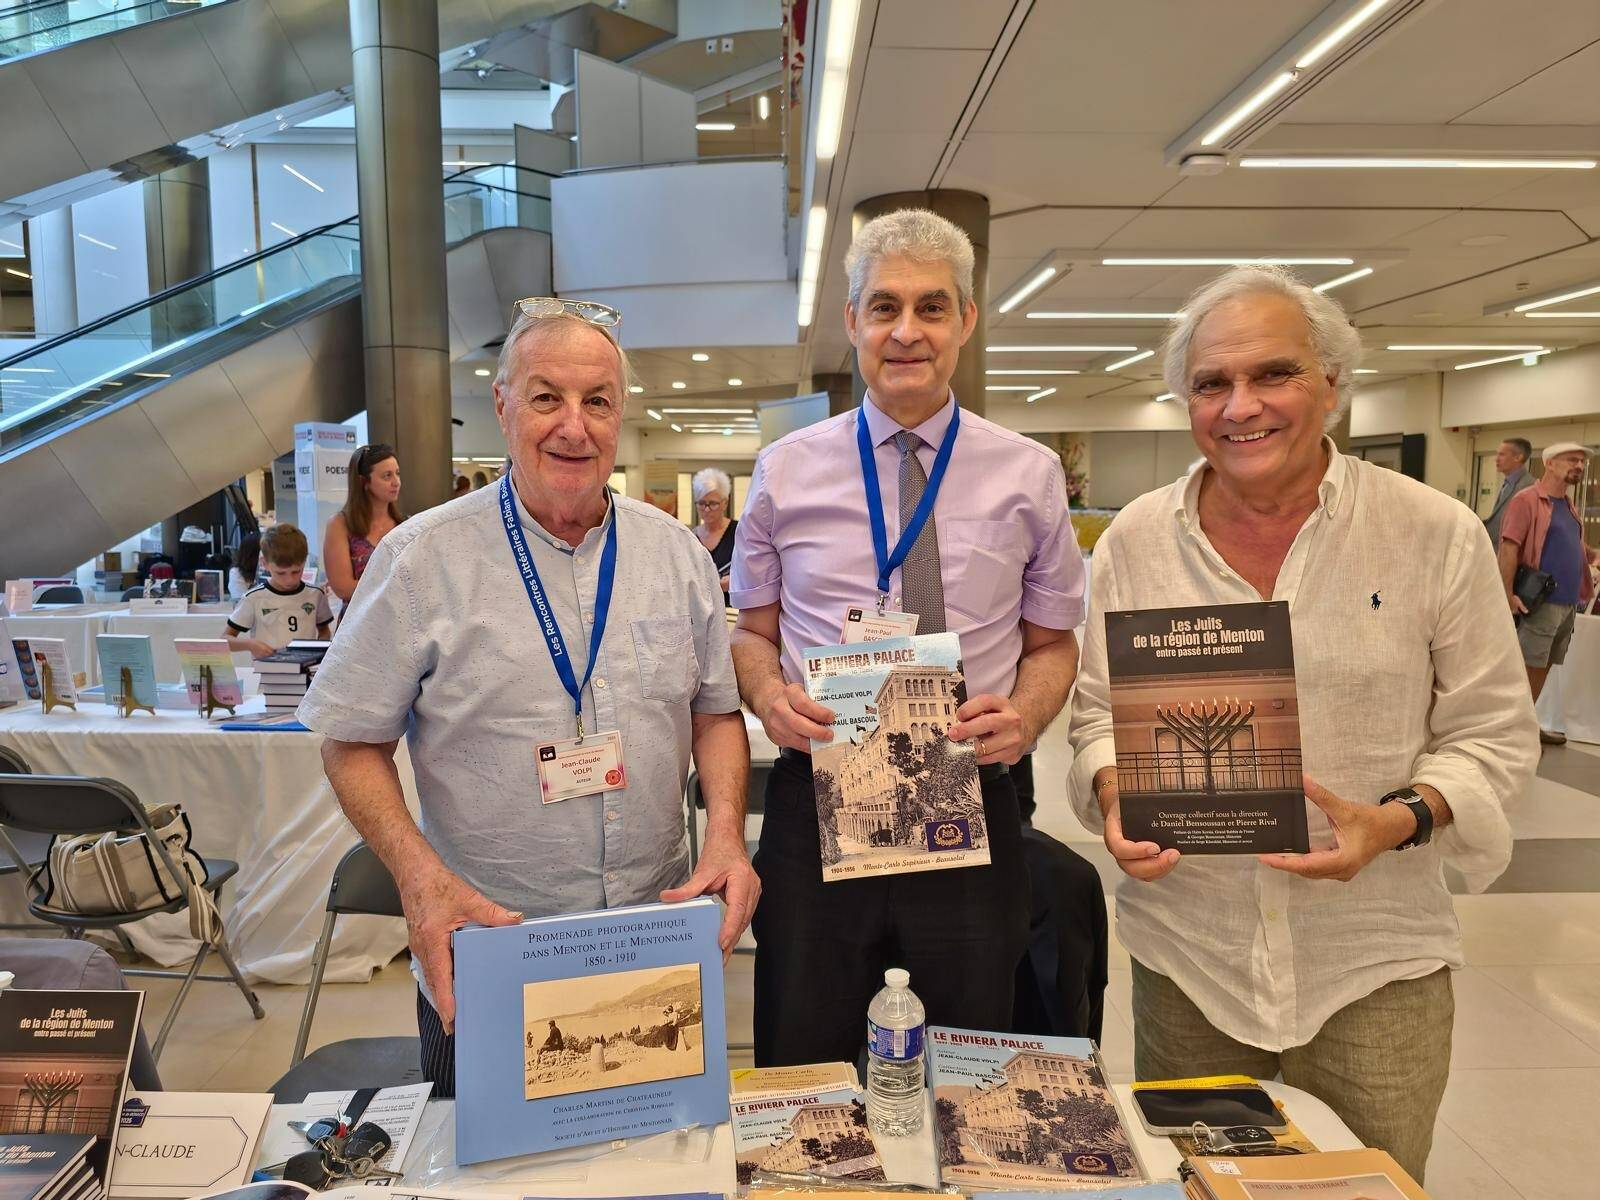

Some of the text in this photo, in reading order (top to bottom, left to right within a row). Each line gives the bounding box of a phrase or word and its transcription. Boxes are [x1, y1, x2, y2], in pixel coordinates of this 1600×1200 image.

[503, 499, 516, 528] Fabian
[512, 529, 534, 578] Littéraires
[530, 580, 555, 636] Rencontres
[288, 616, 298, 632] 9
[1171, 617, 1222, 632] Les Juifs
[864, 628, 892, 636] Jean-Paul
[1133, 628, 1264, 648] de la région de Menton
[552, 636, 562, 656] Les
[1156, 644, 1243, 658] entre passé et présent
[808, 658, 822, 672] LE
[874, 648, 916, 665] PALACE
[814, 692, 854, 702] JEAN-CLAUDE
[850, 716, 878, 725] BASCOUL
[561, 756, 601, 769] Jean-Claude
[572, 766, 592, 776] VOLPI
[1158, 812, 1187, 820] Ouvrage
[1188, 810, 1215, 818] collectif
[1151, 820, 1159, 828] de
[1160, 820, 1184, 828] Daniel
[862, 860, 900, 871] Monte-Carlo
[528, 918, 687, 944] PROMENADE PHOTOGRAPHIQUE
[522, 932, 693, 960] DANS MENTON ET LE MENTONNAIS
[584, 956, 606, 968] 1850
[616, 952, 636, 964] 1910
[50, 1008, 88, 1019] Les Juifs
[20, 1017, 114, 1030] de la région de Menton
[934, 1032, 1044, 1050] LE RIVIERA PALACE
[937, 1053, 980, 1063] JEAN-CLAUDE
[938, 1068, 974, 1077] JEAN-PAUL
[553, 1104, 584, 1114] CHARLES
[586, 1099, 614, 1110] MARTINI
[735, 1105, 746, 1114] LE
[748, 1100, 785, 1112] RIVIERA
[786, 1096, 820, 1106] PALACE
[116, 1144, 196, 1158] N-CLAUDE
[988, 1171, 1034, 1181] Monte-Carlo
